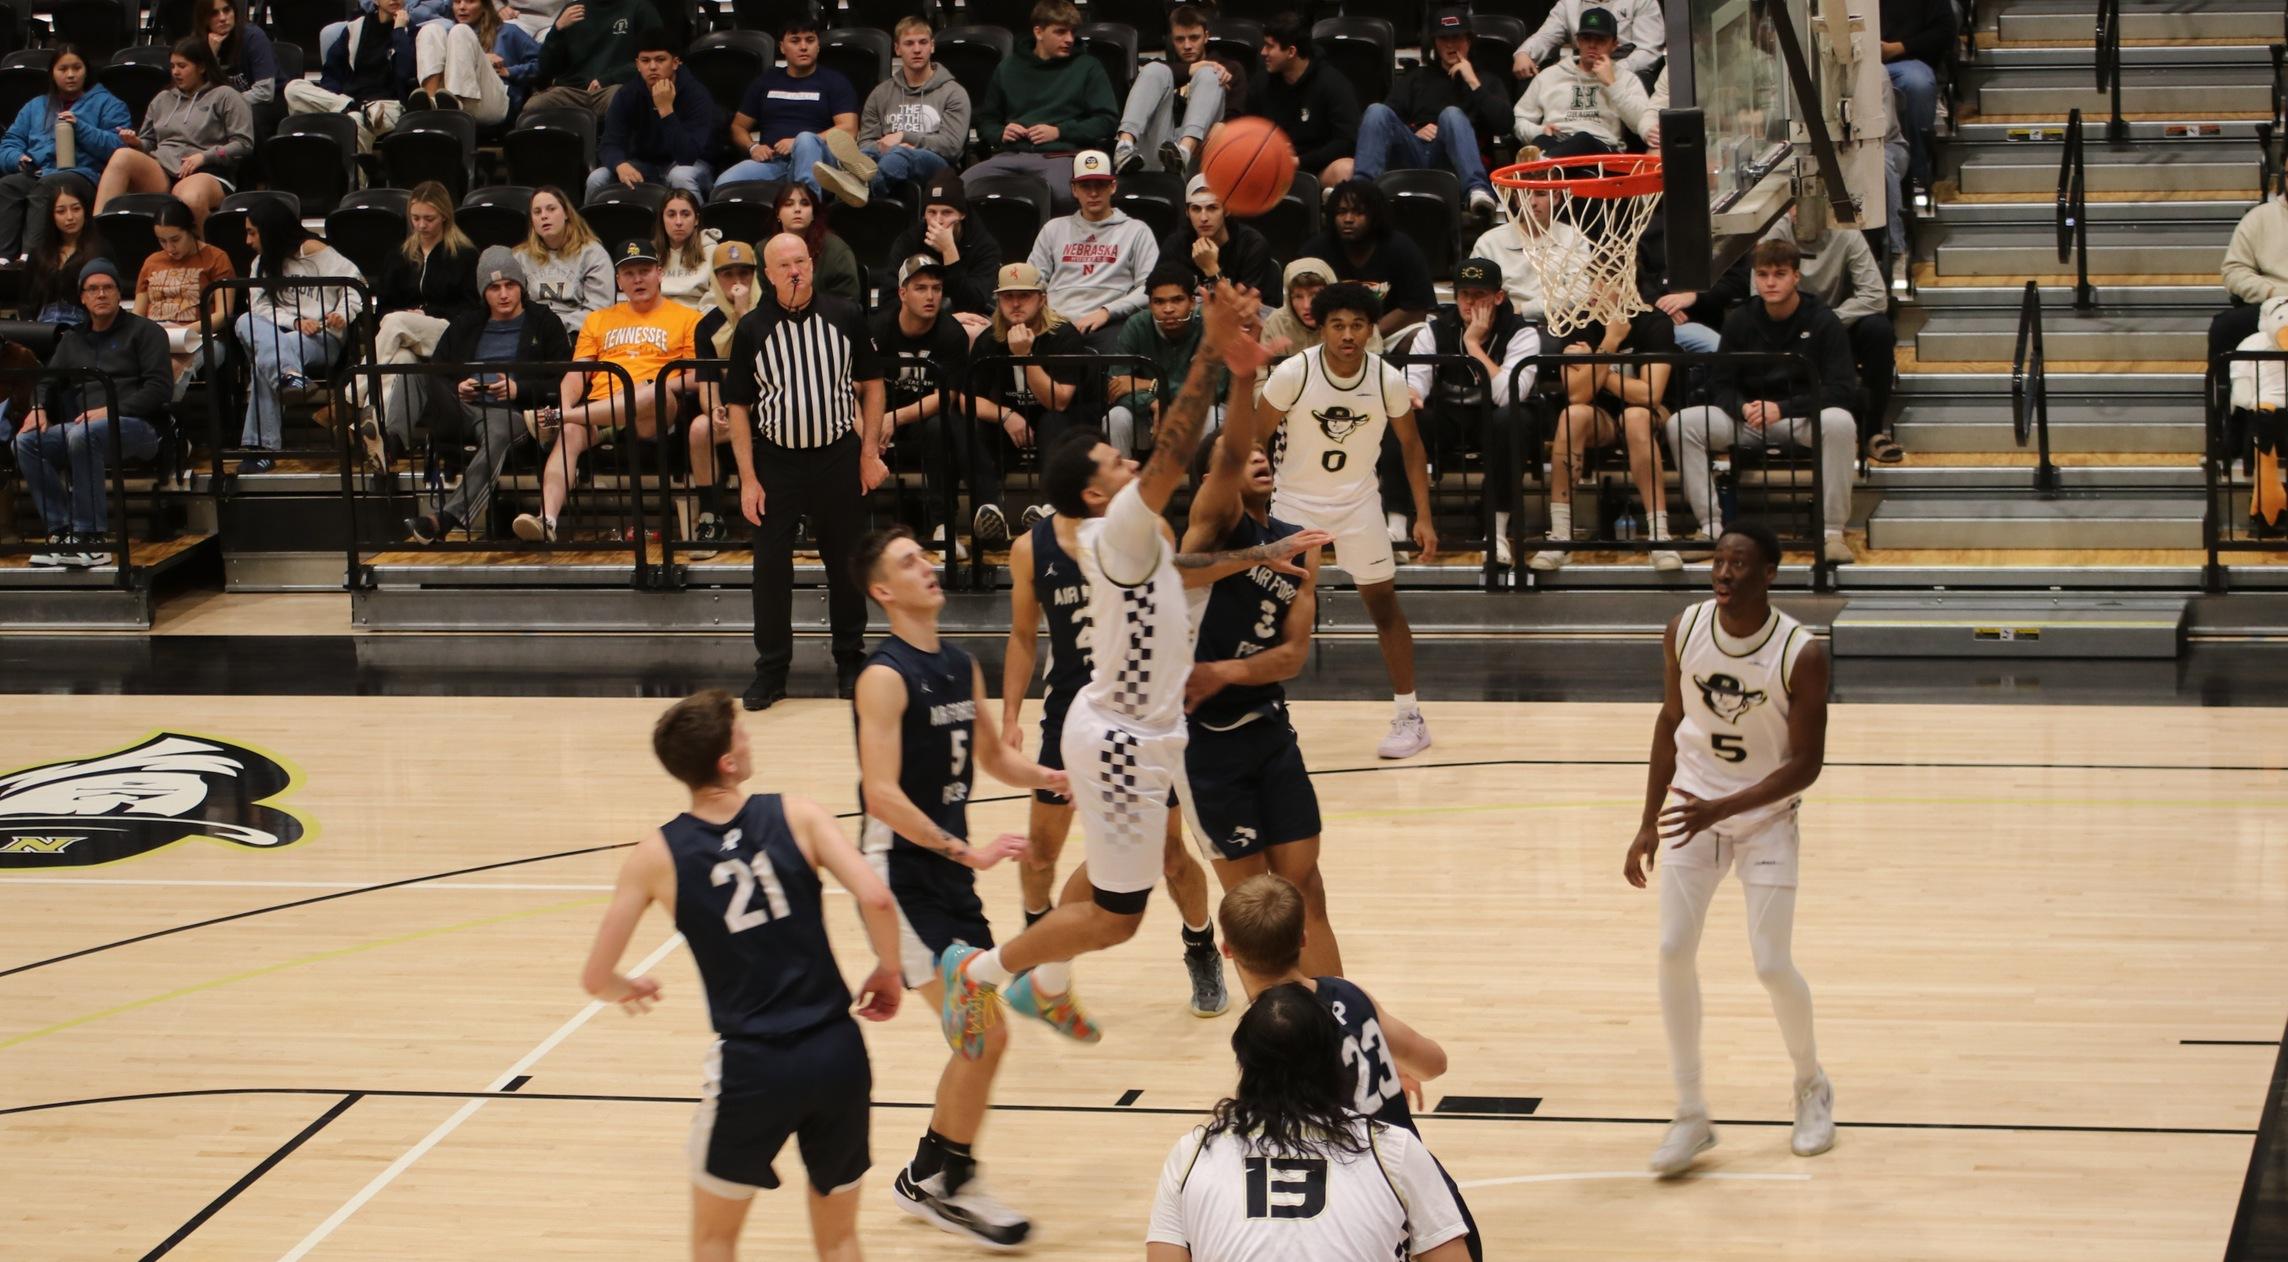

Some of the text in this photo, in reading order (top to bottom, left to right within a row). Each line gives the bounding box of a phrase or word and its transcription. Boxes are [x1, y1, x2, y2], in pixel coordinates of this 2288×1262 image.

[899, 104, 921, 114] THE
[1570, 85, 1600, 110] H
[891, 123, 921, 132] FACE
[1062, 243, 1118, 257] NEBRASKA
[1083, 264, 1095, 276] N
[540, 281, 565, 303] N
[603, 326, 669, 353] TENNESSEE
[1245, 564, 1274, 588] AIR
[1054, 585, 1080, 606] AIR
[1253, 599, 1277, 639] 3
[950, 728, 969, 777] 5
[1711, 733, 1748, 764] 5
[0, 836, 89, 854] N
[709, 848, 792, 935] 21
[1341, 1016, 1402, 1116] 23
[1244, 1156, 1328, 1219] 13
